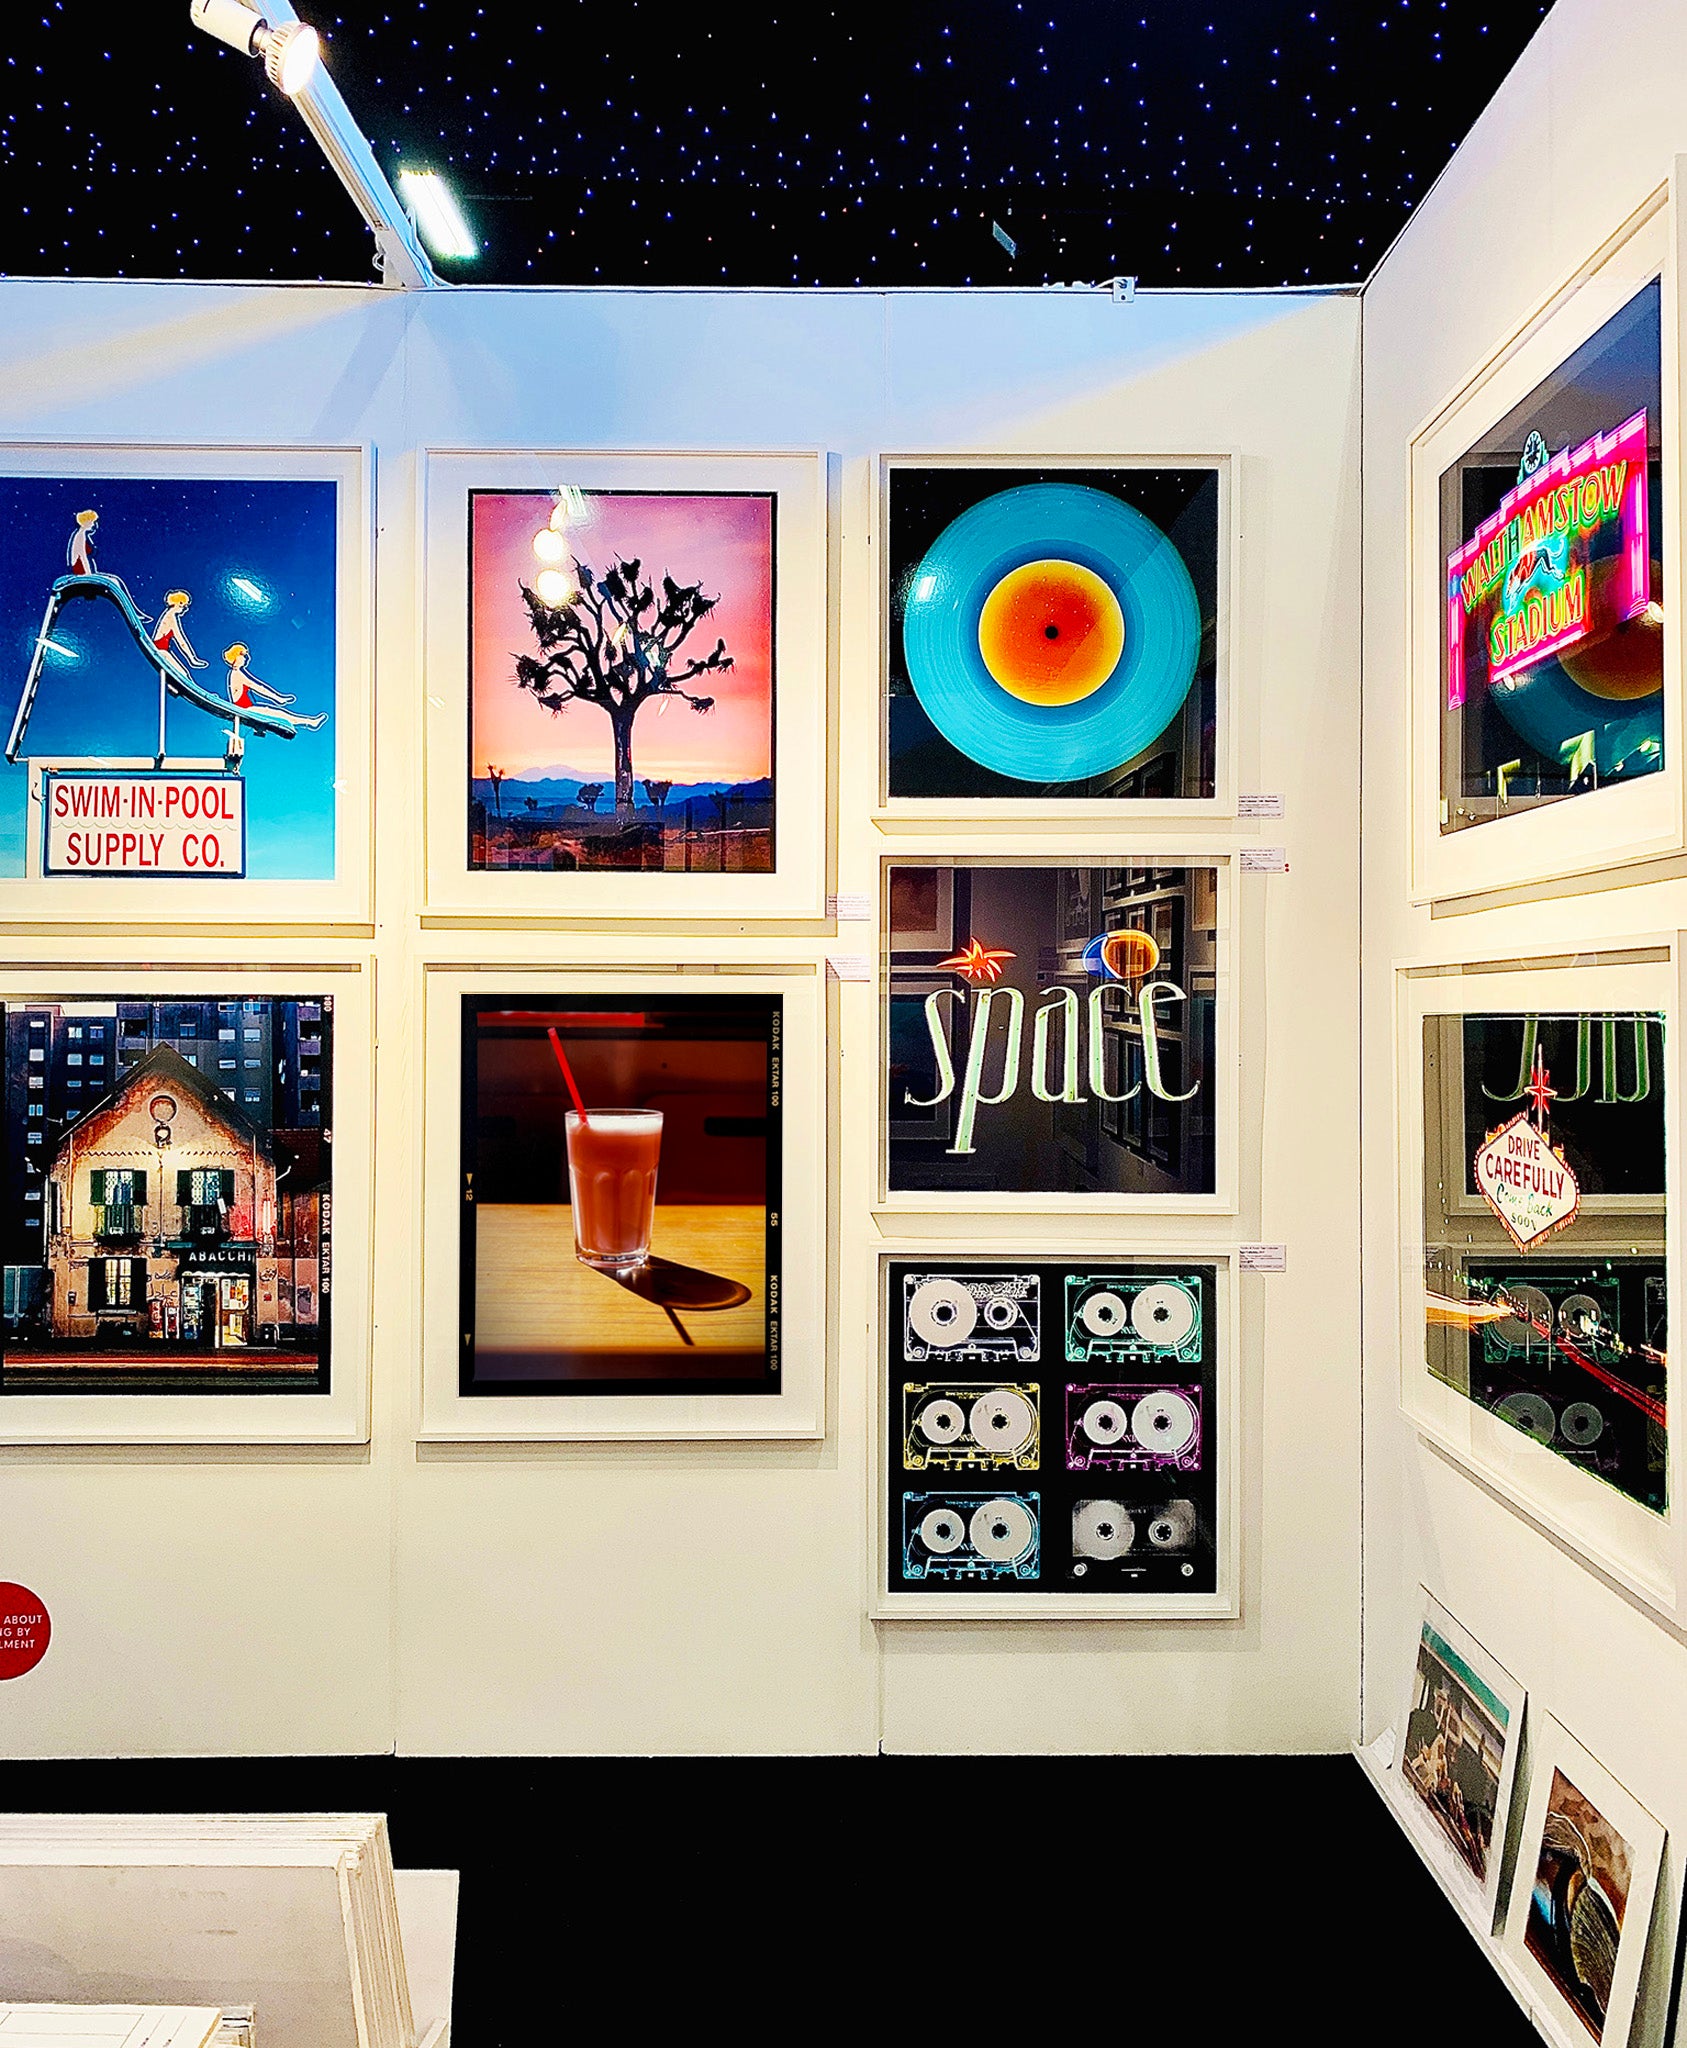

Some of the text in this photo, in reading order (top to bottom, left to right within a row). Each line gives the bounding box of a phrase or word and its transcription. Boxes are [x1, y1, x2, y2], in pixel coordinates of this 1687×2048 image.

[1460, 459, 1628, 611] WALTHAMSTOW
[1491, 574, 1583, 664] STADIUM
[66, 832, 225, 867] SUPPLY CO.
[771, 1011, 780, 1107] KODAK EKTAR 100
[904, 981, 1200, 1154] space
[1508, 1134, 1541, 1161] DRIVE
[465, 1189, 474, 1201] 12
[1485, 1153, 1565, 1200] CAREFULLY
[770, 1212, 779, 1227] 55
[321, 1194, 331, 1293] KODAK EKTAR 100
[770, 1275, 778, 1371] KODAK EKTAR 100
[3, 1614, 43, 1624] ABOUT
[17, 1627, 31, 1637] BY
